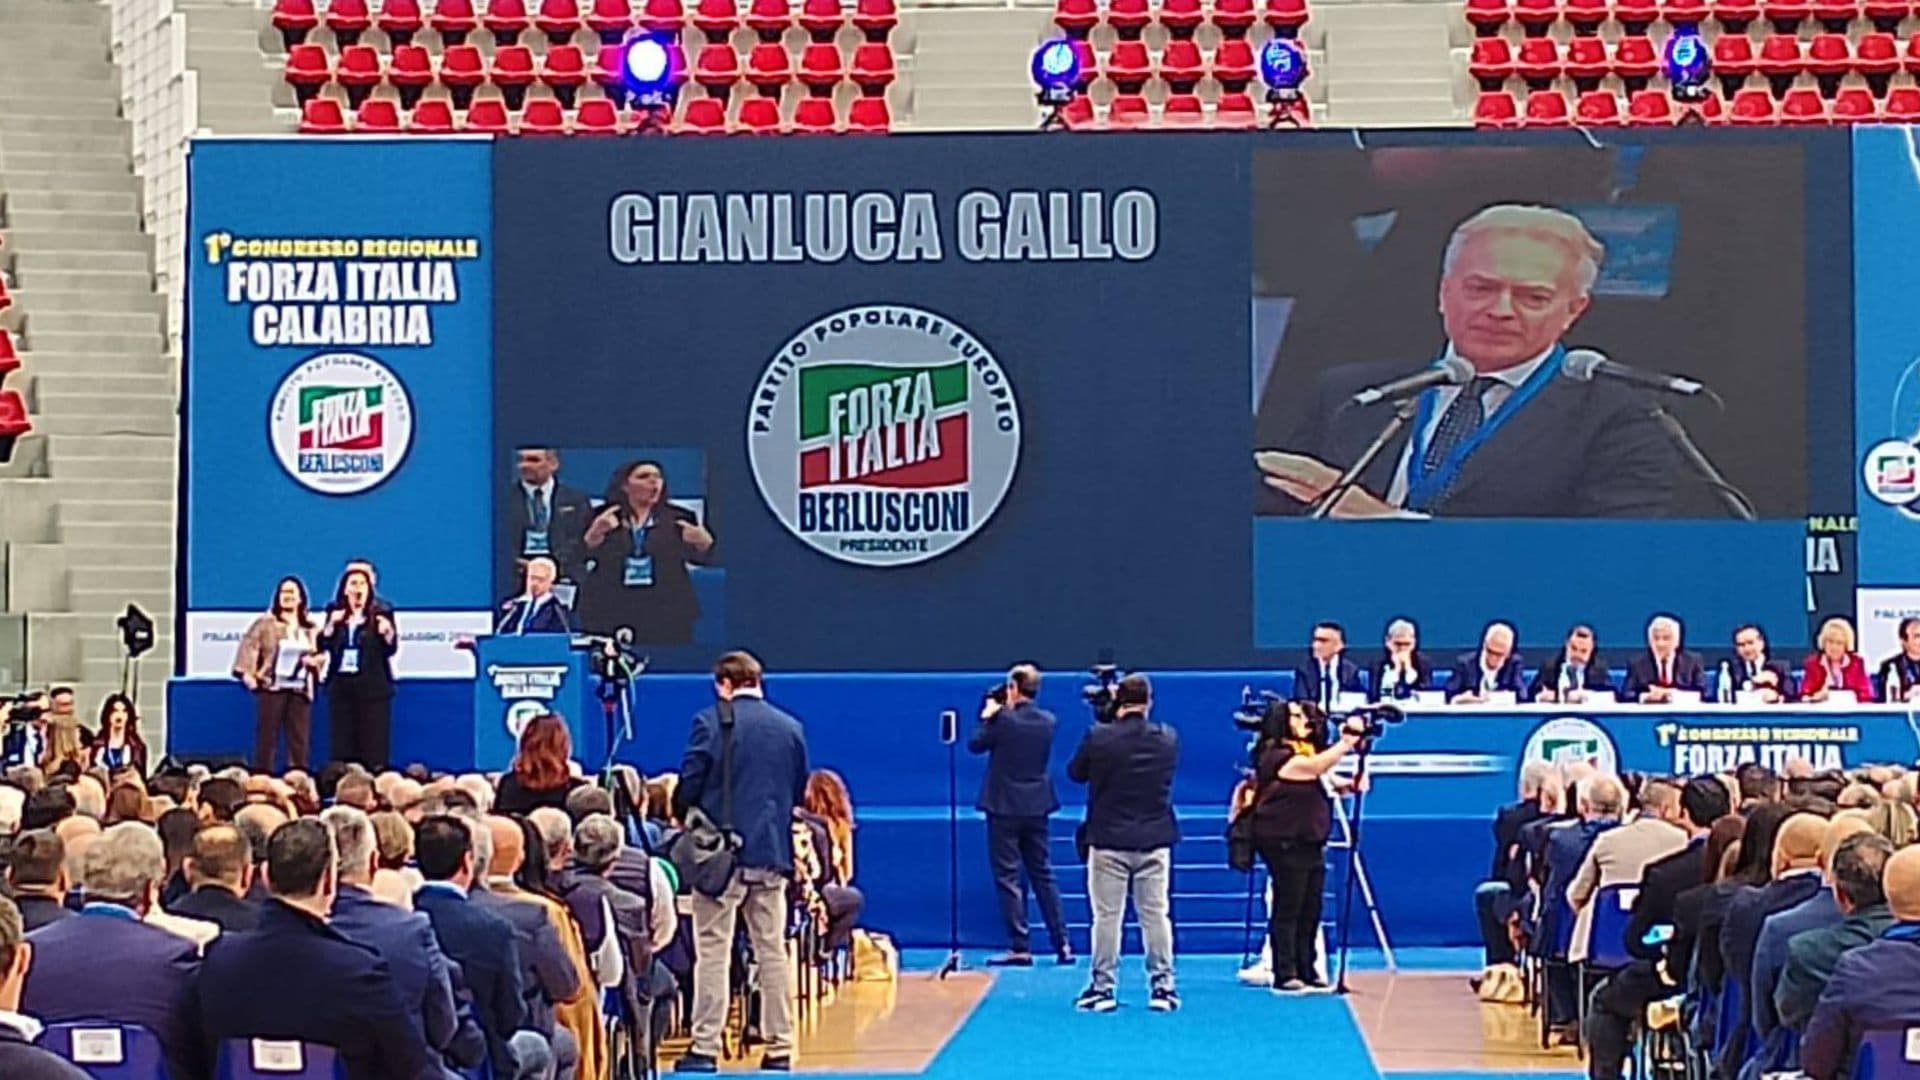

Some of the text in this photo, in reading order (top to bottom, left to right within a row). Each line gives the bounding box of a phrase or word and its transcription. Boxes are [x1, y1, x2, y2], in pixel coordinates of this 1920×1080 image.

[609, 191, 1157, 263] GIANLUCA GALLO
[205, 232, 478, 264] 1° CONGRESSO REGIONALE
[227, 262, 457, 302] FORZA ITALIA
[252, 304, 432, 345] CALABRIA
[754, 309, 1014, 433] PARTITO POPOLARE EUROPEO
[829, 370, 934, 435] FORZA
[829, 414, 941, 482] ITALIA
[800, 491, 969, 532] BERLUSCONI
[840, 538, 929, 552] PRESIDENTE
[1674, 744, 1755, 775] FORZA
